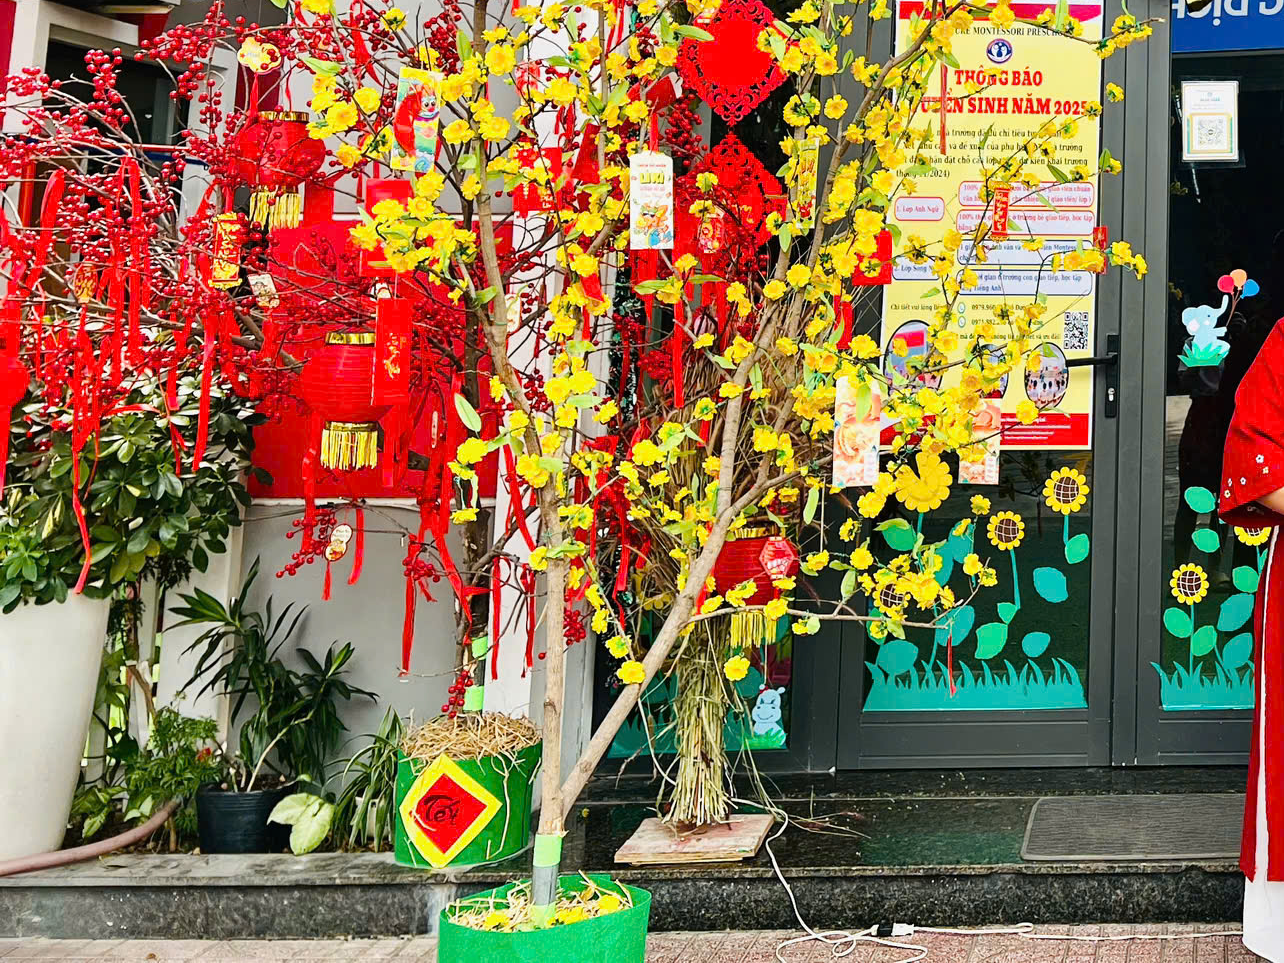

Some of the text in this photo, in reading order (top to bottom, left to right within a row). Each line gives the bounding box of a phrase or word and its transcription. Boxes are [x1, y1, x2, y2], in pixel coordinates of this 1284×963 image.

[1012, 66, 1043, 86] BÁO
[967, 96, 1008, 114] SINH
[1012, 92, 1051, 114] NĂM
